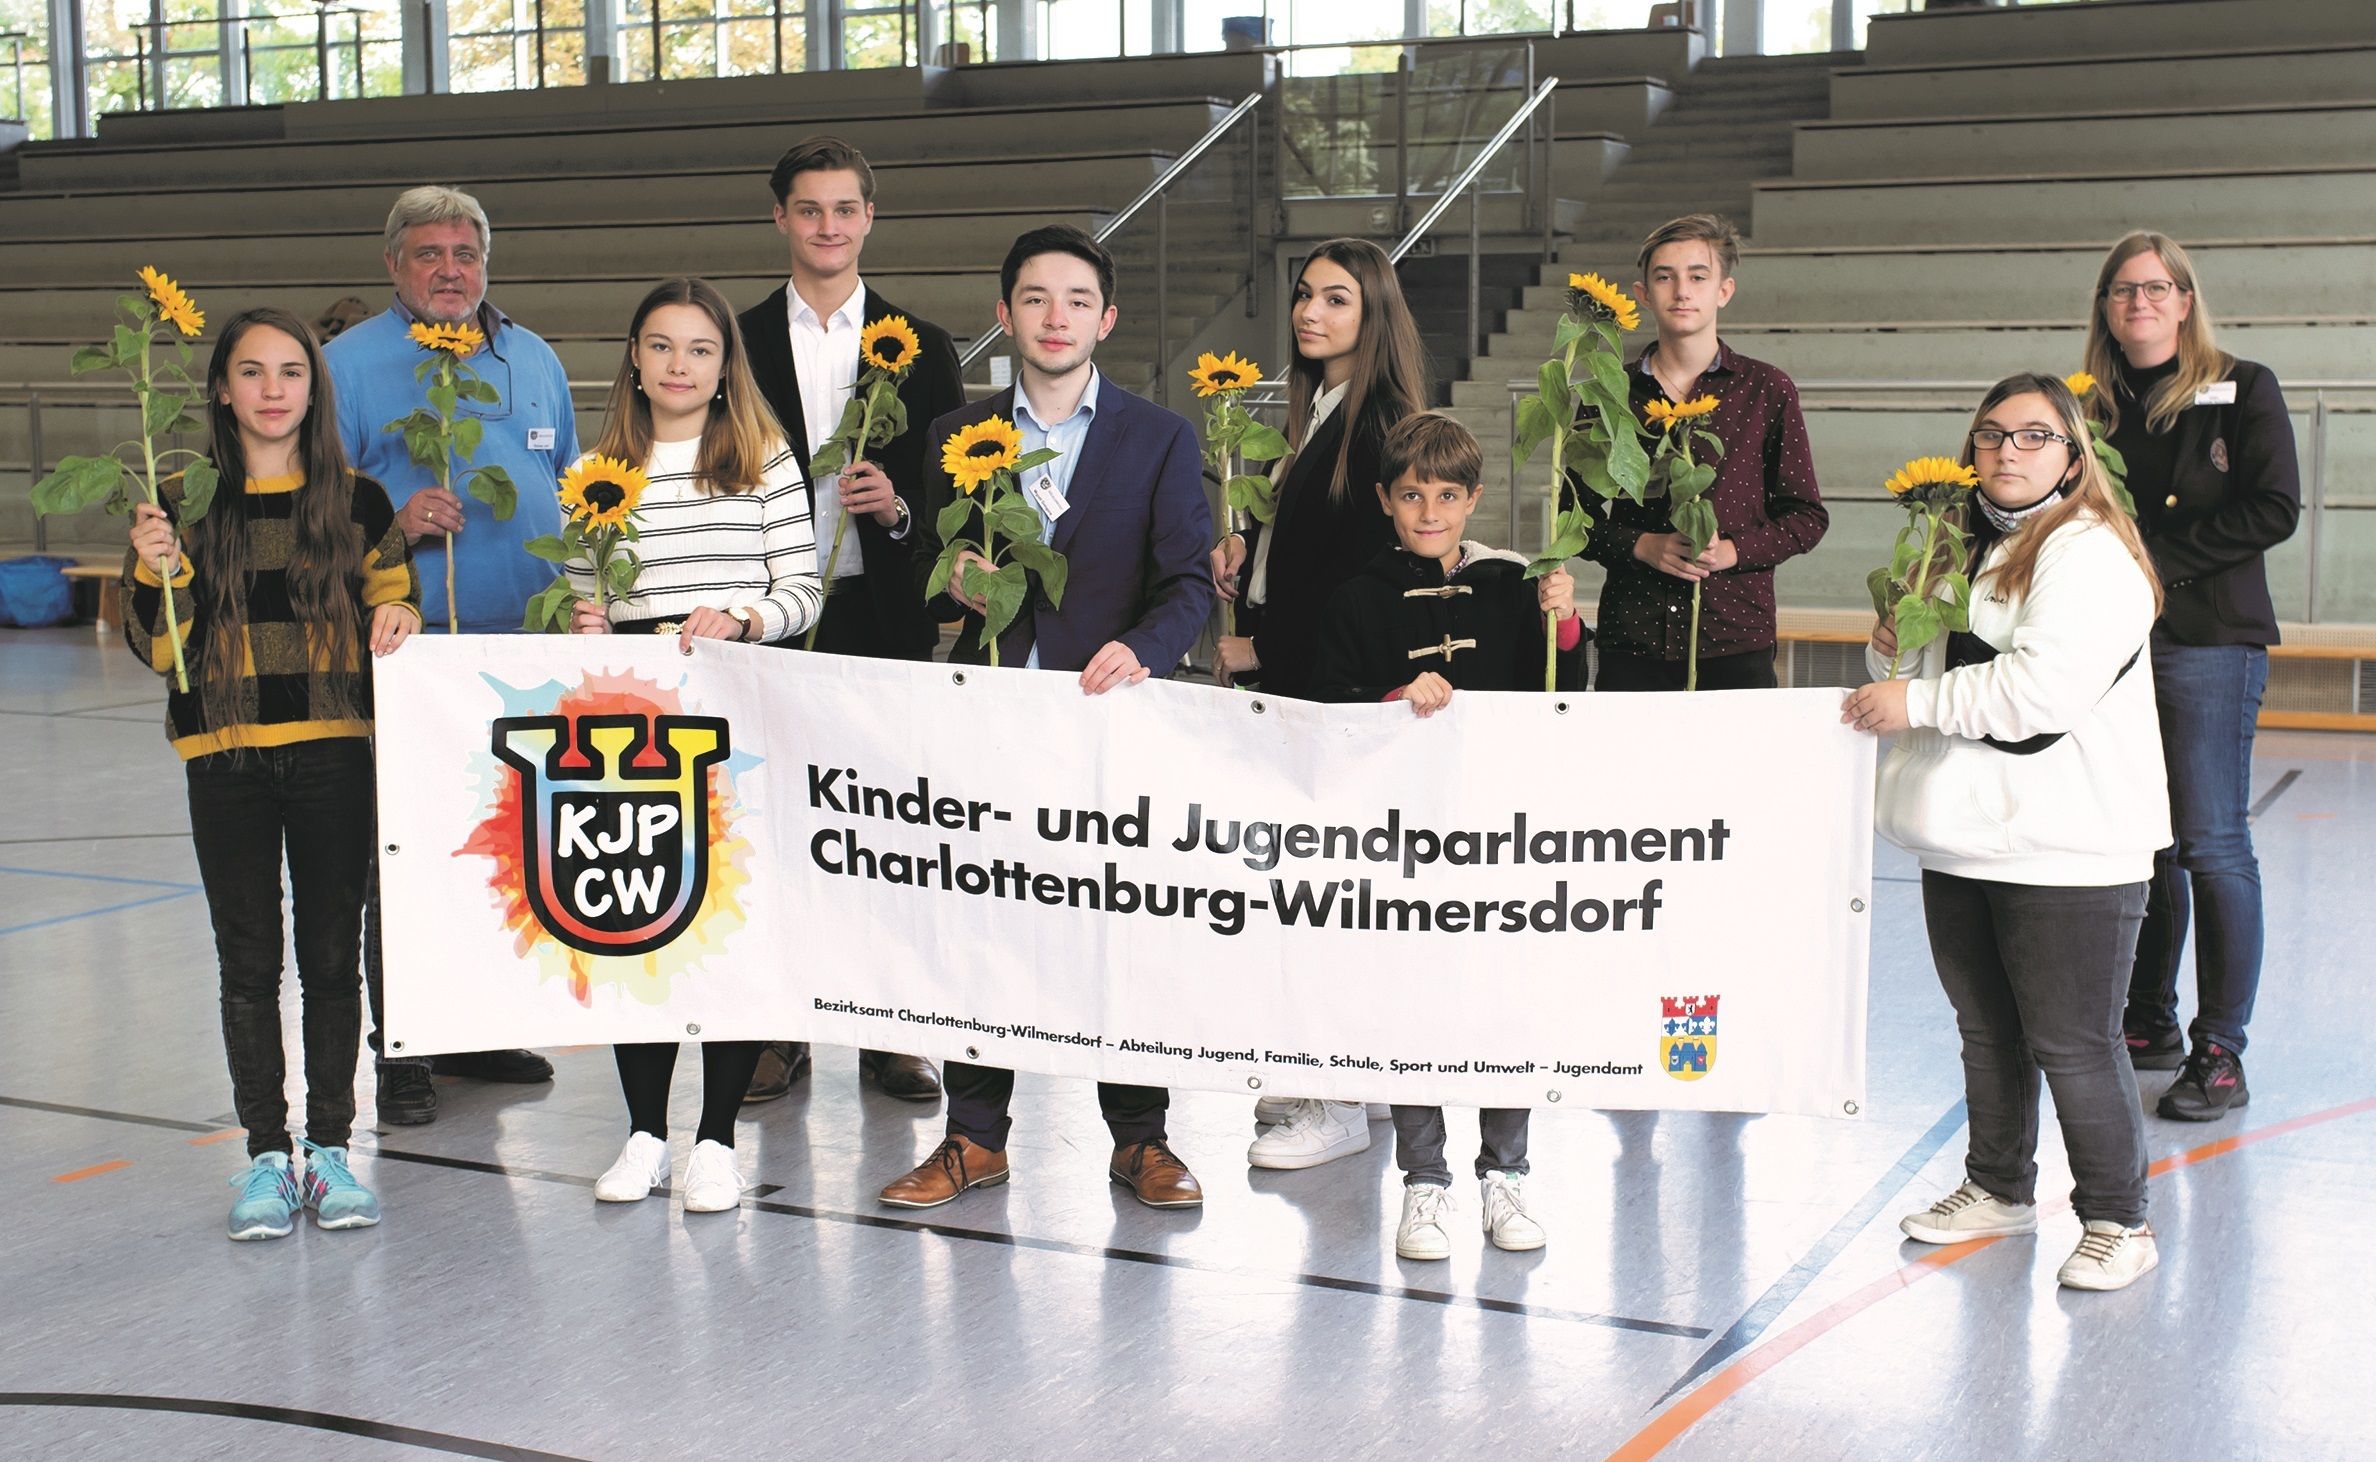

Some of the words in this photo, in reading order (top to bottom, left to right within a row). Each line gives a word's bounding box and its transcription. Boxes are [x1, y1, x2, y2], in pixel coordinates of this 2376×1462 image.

[557, 802, 680, 860] KJP
[807, 763, 1012, 833] Kinder-
[1037, 795, 1151, 848] und
[1171, 803, 1731, 879] Jugendparlament
[573, 864, 666, 918] CW
[810, 827, 1663, 936] Charlottenburg-Wilmersdorf
[814, 997, 894, 1019] Bezirksamt
[897, 1008, 1103, 1049] Charlottenburg-Wilmersdorf
[1118, 1038, 1193, 1060] Abteilung
[1197, 1046, 1260, 1063] Jugend,
[1264, 1050, 1324, 1069] Familie,
[1329, 1054, 1384, 1072] Schule,
[1389, 1059, 1433, 1075] Sport
[1437, 1060, 1469, 1074] und
[1473, 1060, 1536, 1074] Umwelt
[1553, 1060, 1644, 1078] Jugendamt
